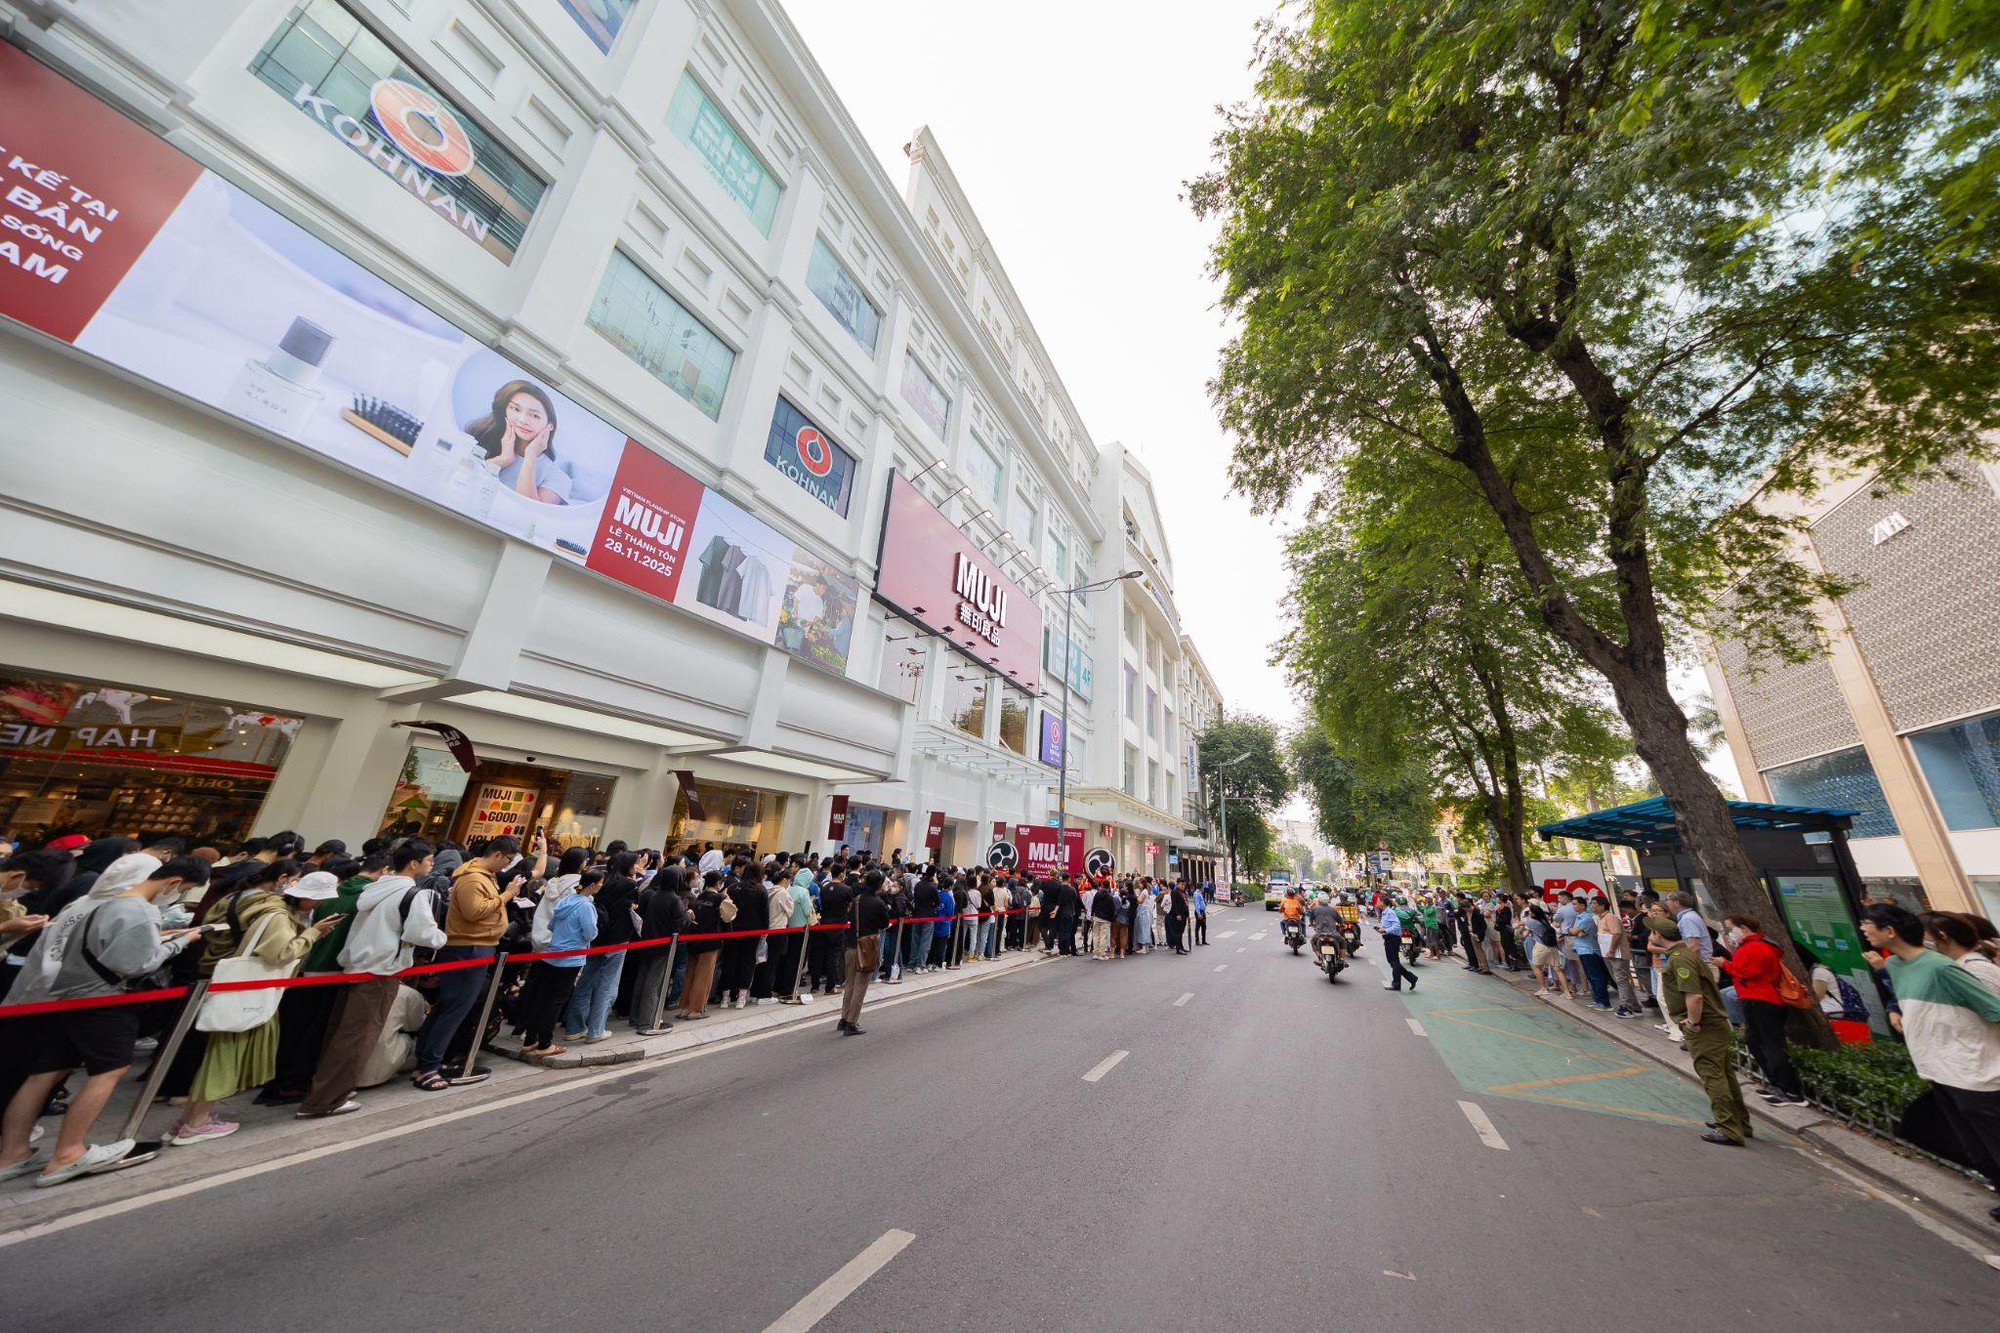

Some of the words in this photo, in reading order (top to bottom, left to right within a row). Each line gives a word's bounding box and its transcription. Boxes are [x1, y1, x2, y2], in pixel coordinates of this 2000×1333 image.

[294, 82, 489, 241] KOHNAN
[5, 185, 103, 243] BẢN
[8, 155, 69, 191] KẾ
[69, 185, 119, 222] TẠI
[0, 214, 84, 262] SỐNG
[622, 486, 646, 503] VIETNAM
[775, 455, 838, 511] KOHNAN
[609, 525, 623, 537] LÊ
[624, 532, 657, 554] THÁNH
[658, 549, 676, 564] TÔN
[613, 494, 684, 552] MUJI
[604, 537, 673, 577] 28.11.2025
[956, 552, 1008, 628] MUJI
[482, 788, 512, 801] MUJI
[488, 811, 518, 823] GOOD
